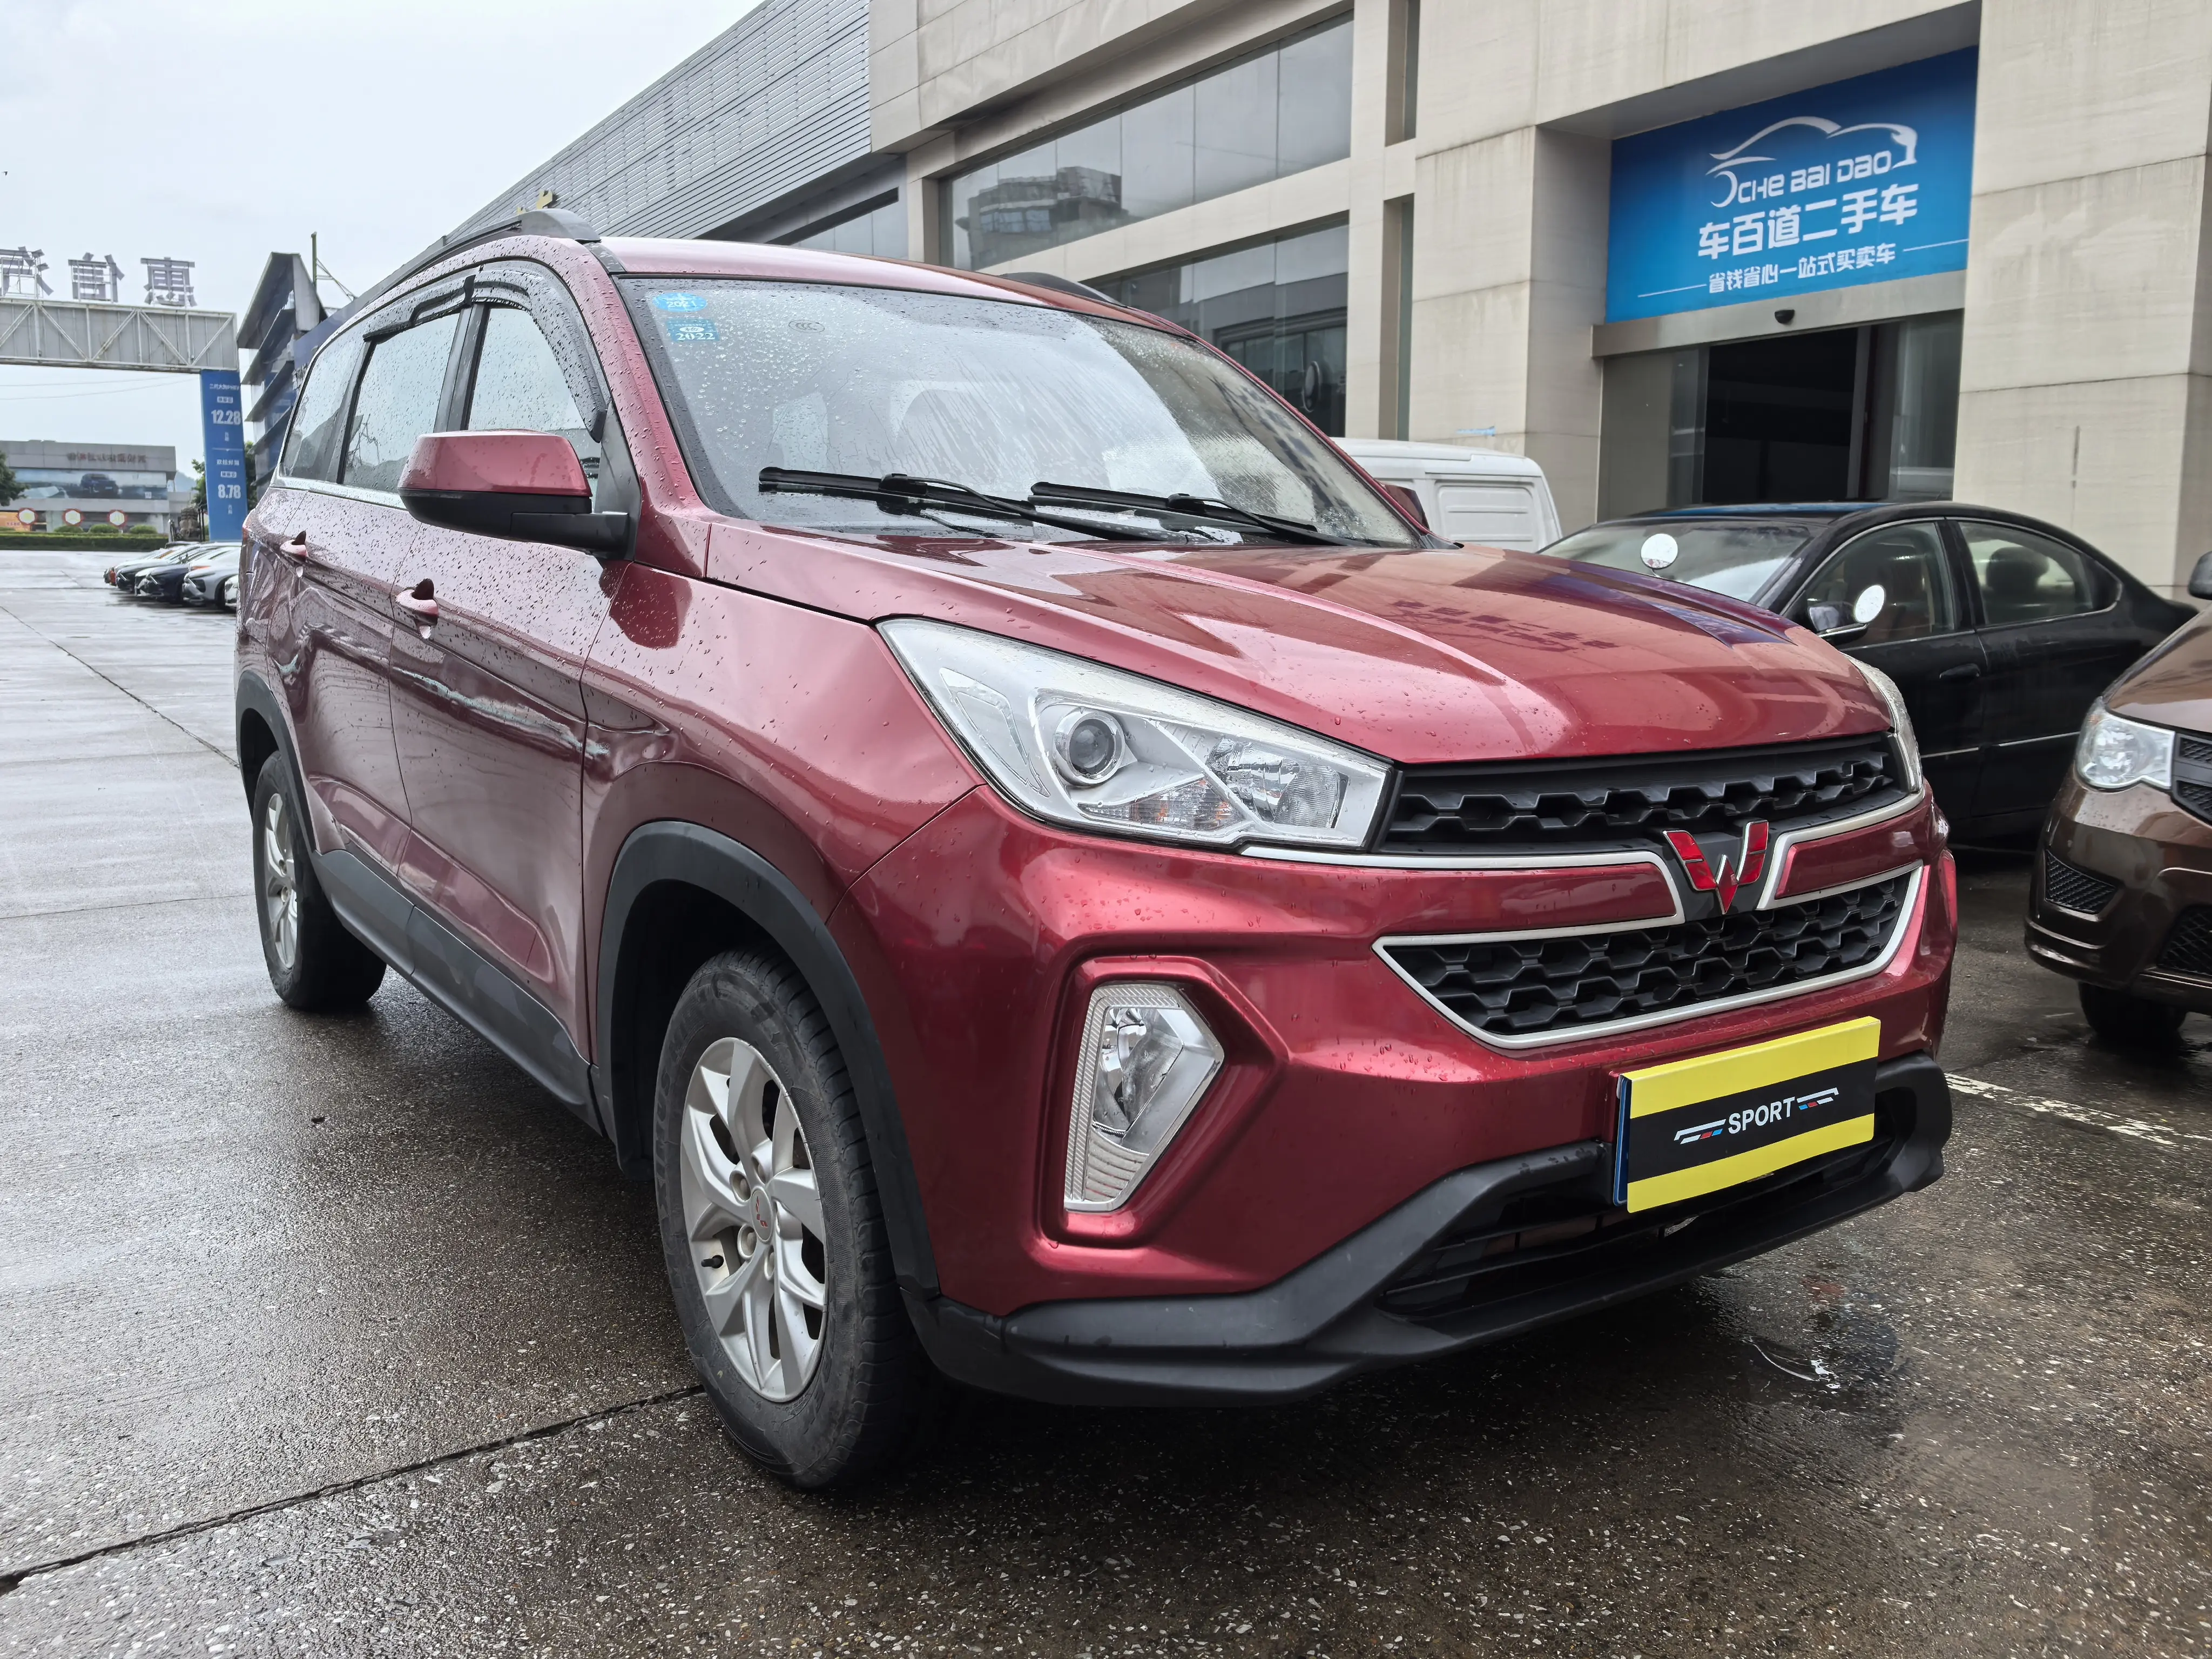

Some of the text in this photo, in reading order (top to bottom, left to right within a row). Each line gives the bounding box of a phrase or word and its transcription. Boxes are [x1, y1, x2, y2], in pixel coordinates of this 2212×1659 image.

[1698, 183, 1919, 259] 车百道二手车
[1709, 243, 1896, 293] 省钱省心一站式买卖车
[676, 332, 716, 341] 2022
[211, 409, 241, 425] 12.28
[218, 484, 241, 498] 8.78
[1728, 1096, 1795, 1134] SPORT
